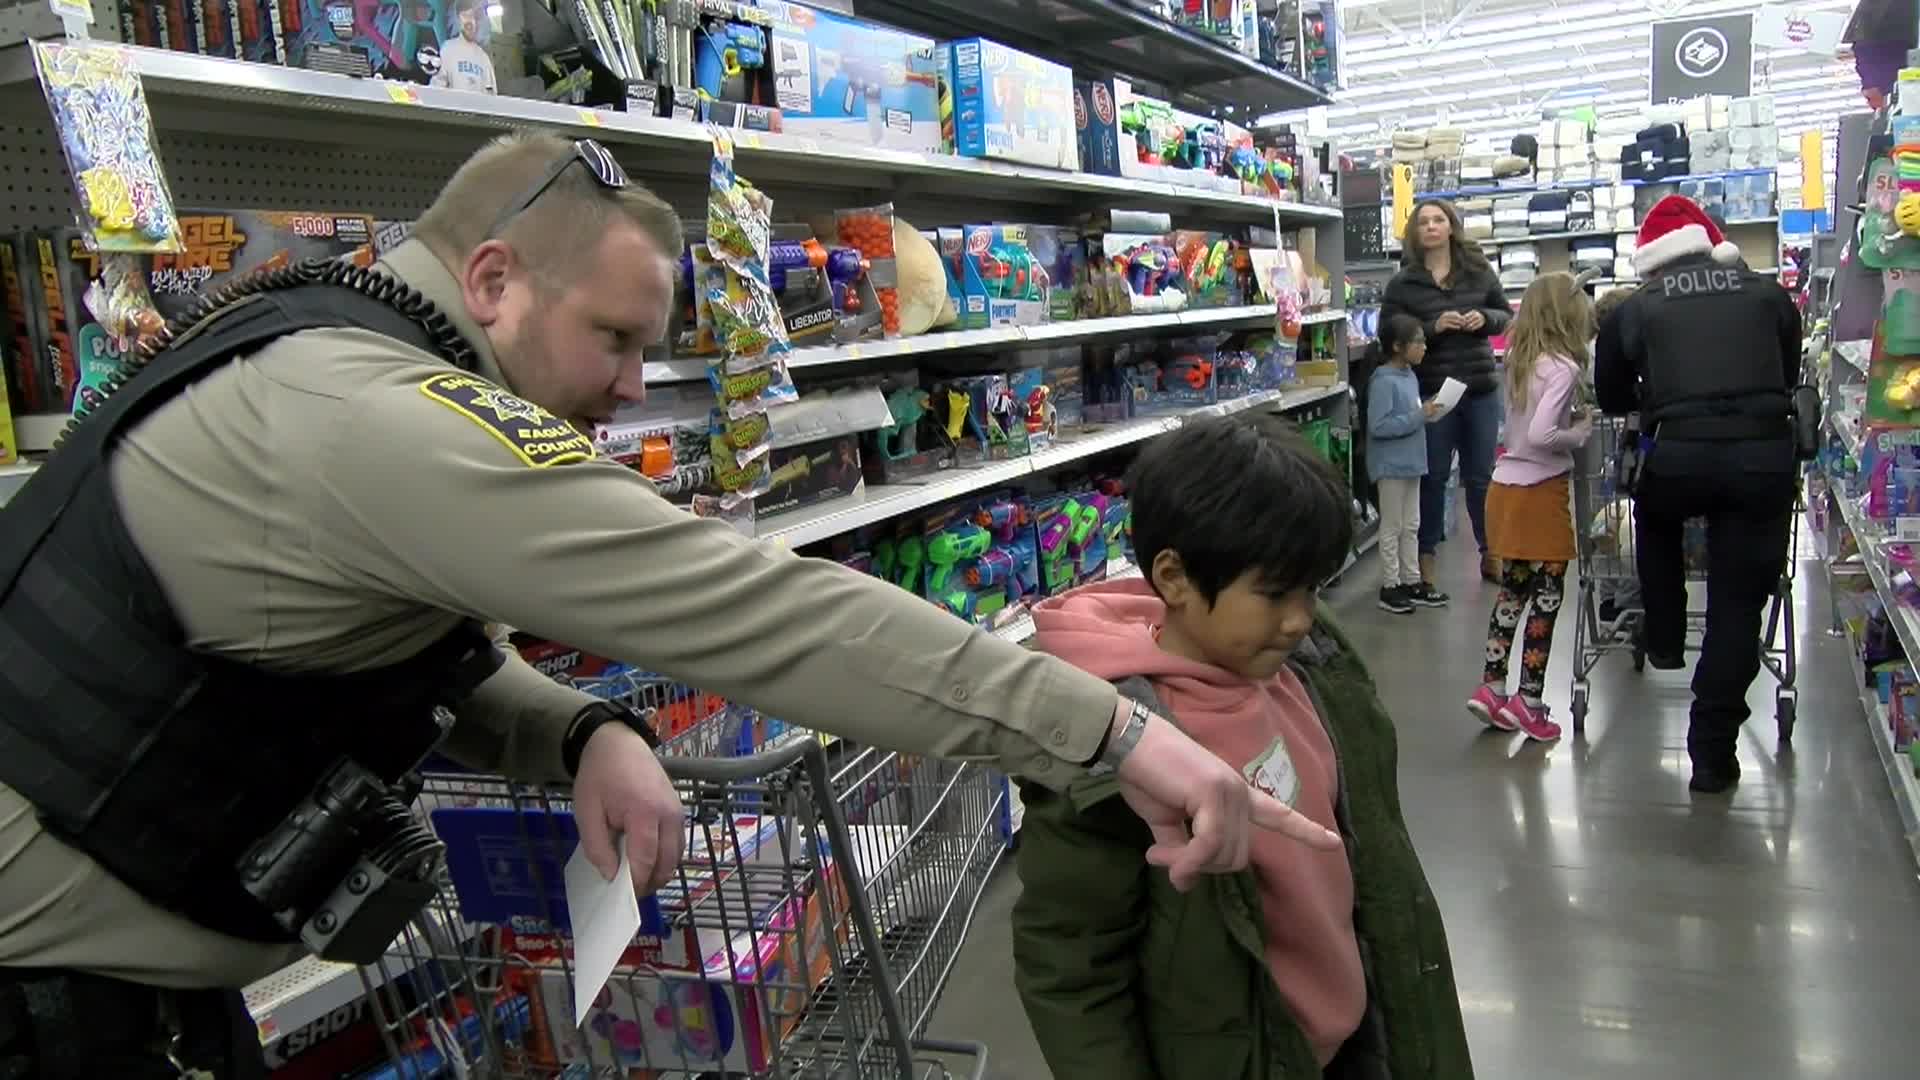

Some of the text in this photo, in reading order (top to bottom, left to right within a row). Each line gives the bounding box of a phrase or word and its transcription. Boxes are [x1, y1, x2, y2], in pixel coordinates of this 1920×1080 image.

[704, 0, 733, 14] RIVAL
[1095, 83, 1112, 122] NERF
[293, 216, 334, 237] 5,000
[1663, 269, 1742, 297] POLICE
[791, 308, 832, 331] LIBERATOR
[518, 426, 572, 439] EAGLE
[524, 435, 589, 456] COUNTY
